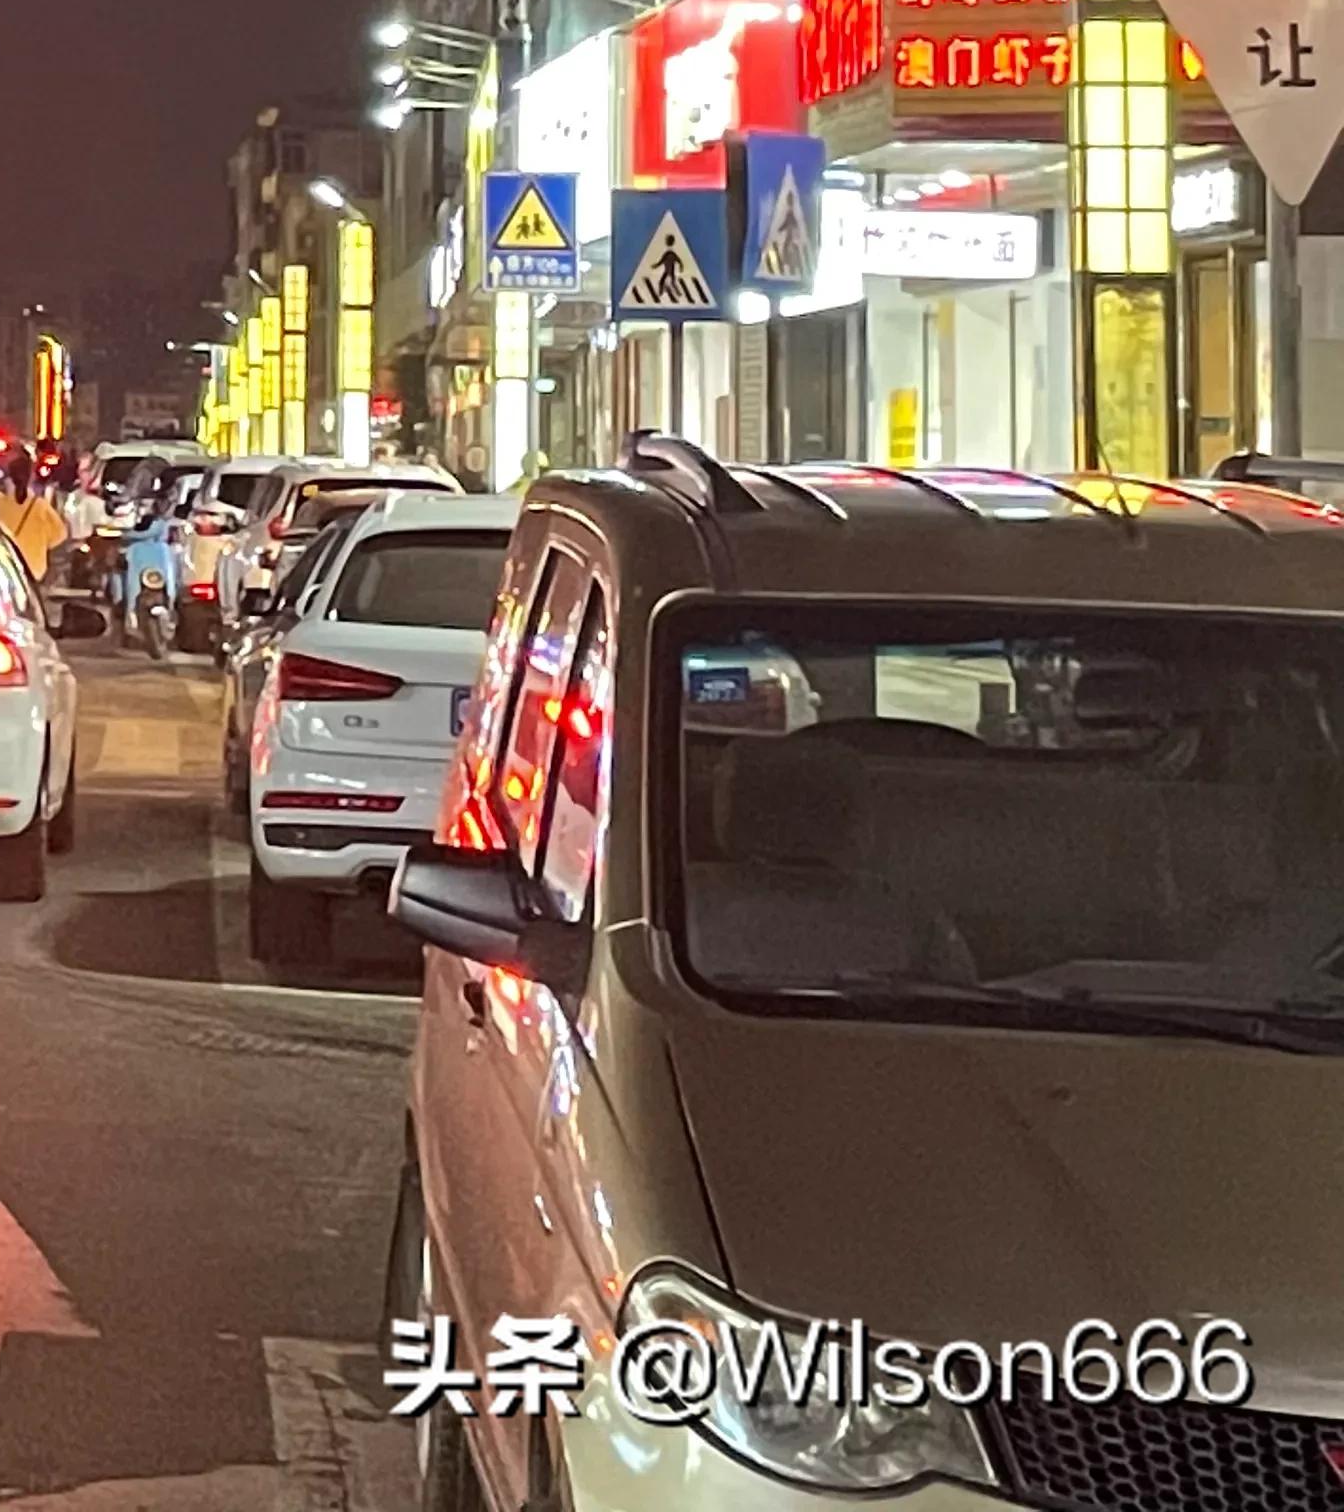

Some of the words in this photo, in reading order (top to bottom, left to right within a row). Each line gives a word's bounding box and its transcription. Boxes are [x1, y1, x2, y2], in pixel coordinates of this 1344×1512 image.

[896, 37, 1070, 88] 澳门虾子
[1246, 22, 1317, 87] 让
